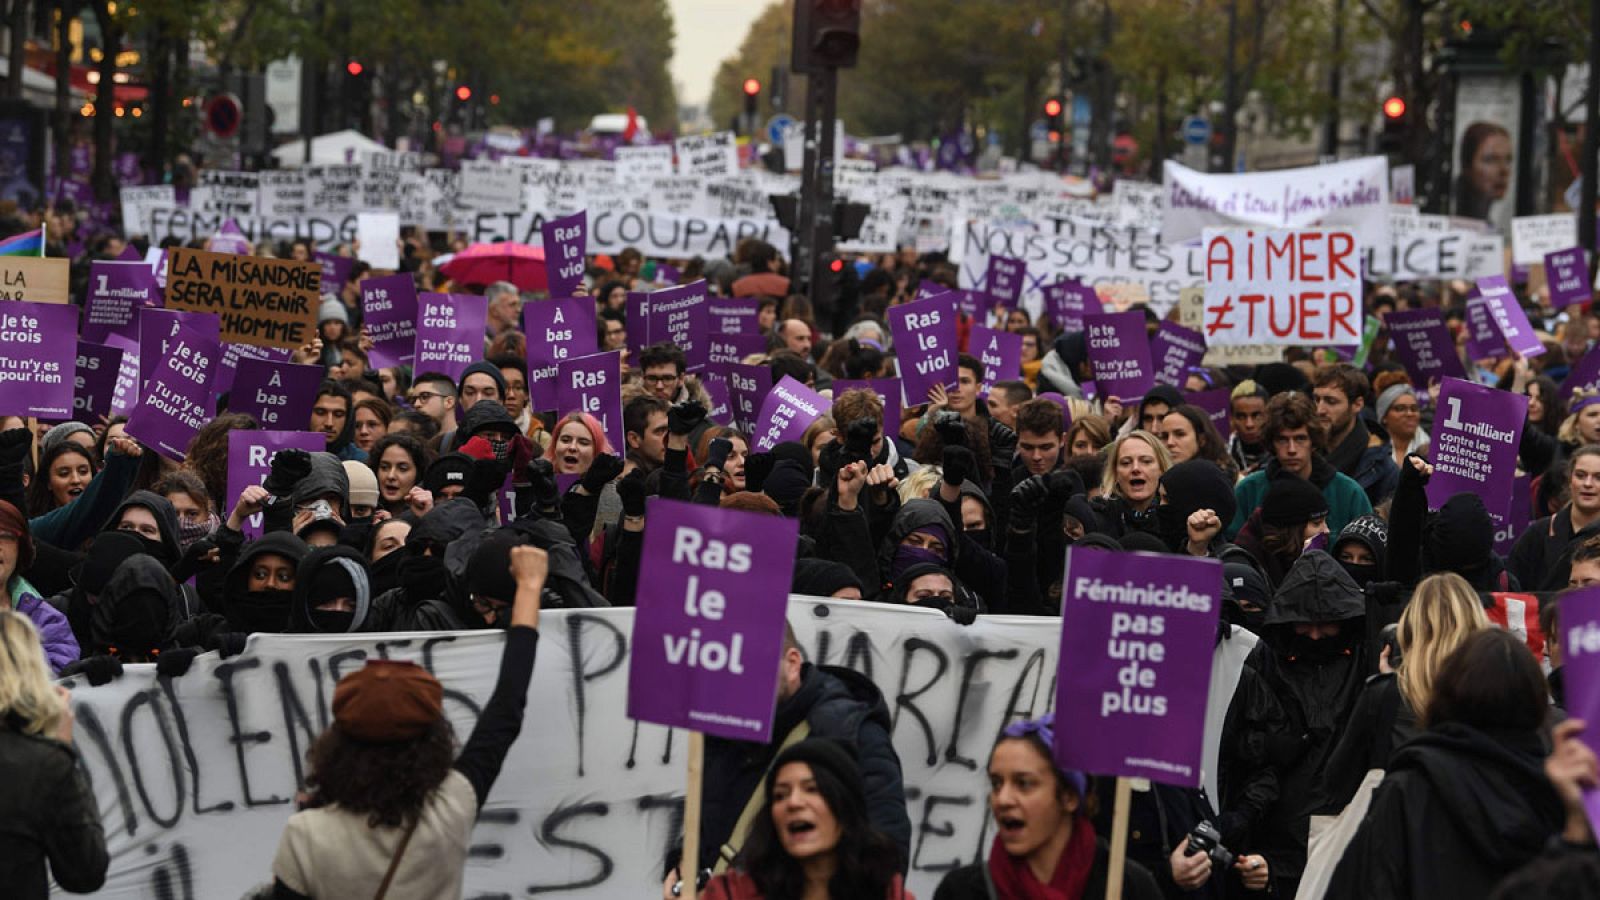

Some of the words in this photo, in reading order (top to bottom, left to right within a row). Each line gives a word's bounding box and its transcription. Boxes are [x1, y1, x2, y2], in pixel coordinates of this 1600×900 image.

[555, 225, 581, 243] Ras
[564, 244, 578, 259] le
[965, 222, 1047, 261] NOUS
[1052, 239, 1174, 272] SOMMES
[172, 252, 203, 279] LA
[560, 256, 585, 279] viol
[4, 269, 26, 288] LA
[110, 288, 148, 299] milliard
[171, 280, 225, 306] SERA
[364, 289, 374, 303] Je
[375, 288, 388, 299] te
[365, 298, 393, 312] crois
[424, 303, 438, 317] Je
[440, 304, 454, 317] te
[652, 294, 705, 313] Féminicides
[1, 314, 17, 329] Je
[21, 315, 38, 329] te
[424, 316, 457, 329] crois
[553, 307, 565, 324] À
[668, 310, 689, 324] pas
[904, 310, 941, 331] Ras
[0, 329, 42, 343] crois
[546, 328, 573, 342] bas
[668, 321, 690, 333] une
[1088, 324, 1101, 338] Je
[1102, 324, 1116, 336] te
[422, 340, 437, 350] Tu
[456, 344, 470, 353] es
[672, 332, 688, 343] de
[918, 332, 938, 352] le
[1090, 336, 1121, 349] crois
[173, 341, 191, 359] Je
[192, 352, 209, 369] te
[553, 344, 568, 359] le
[709, 341, 722, 355] Je
[724, 343, 737, 355] te
[0, 357, 17, 369] Tu
[44, 362, 59, 372] es
[76, 355, 100, 369] as
[421, 352, 447, 363] pour
[448, 352, 472, 363] rien
[916, 348, 951, 375] viol
[982, 350, 1002, 367] bas
[1094, 360, 1106, 370] Tu
[1124, 360, 1139, 368] es
[0, 371, 31, 384] pour
[35, 371, 61, 383] rien
[168, 356, 206, 384] crois
[268, 370, 282, 387] À
[984, 366, 997, 381] le
[1120, 368, 1142, 379] rien
[74, 376, 86, 388] e
[572, 370, 606, 389] Ras
[732, 372, 757, 392] Ras
[155, 380, 171, 399] Tu
[256, 388, 288, 406] bas
[146, 394, 179, 417] pour
[582, 393, 601, 413] le
[740, 394, 753, 413] le
[773, 386, 820, 417] Féminicides
[262, 408, 279, 423] le
[776, 404, 797, 418] pas
[1444, 396, 1464, 431] 1
[1464, 422, 1515, 444] milliard
[770, 414, 789, 429] une
[768, 425, 781, 439] de
[1440, 432, 1474, 448] contre
[1476, 440, 1491, 453] les
[1439, 442, 1489, 462] violences
[1435, 462, 1487, 482] sexuelles
[1437, 452, 1481, 470] sexistes
[1482, 463, 1493, 474] et
[672, 526, 753, 573] Ras
[684, 574, 727, 621] le
[1074, 577, 1212, 613] Féminicides
[1110, 612, 1166, 638] pas
[663, 628, 744, 675] viol
[1108, 637, 1165, 662] une
[1118, 660, 1156, 688] de
[1101, 687, 1168, 718] plus
